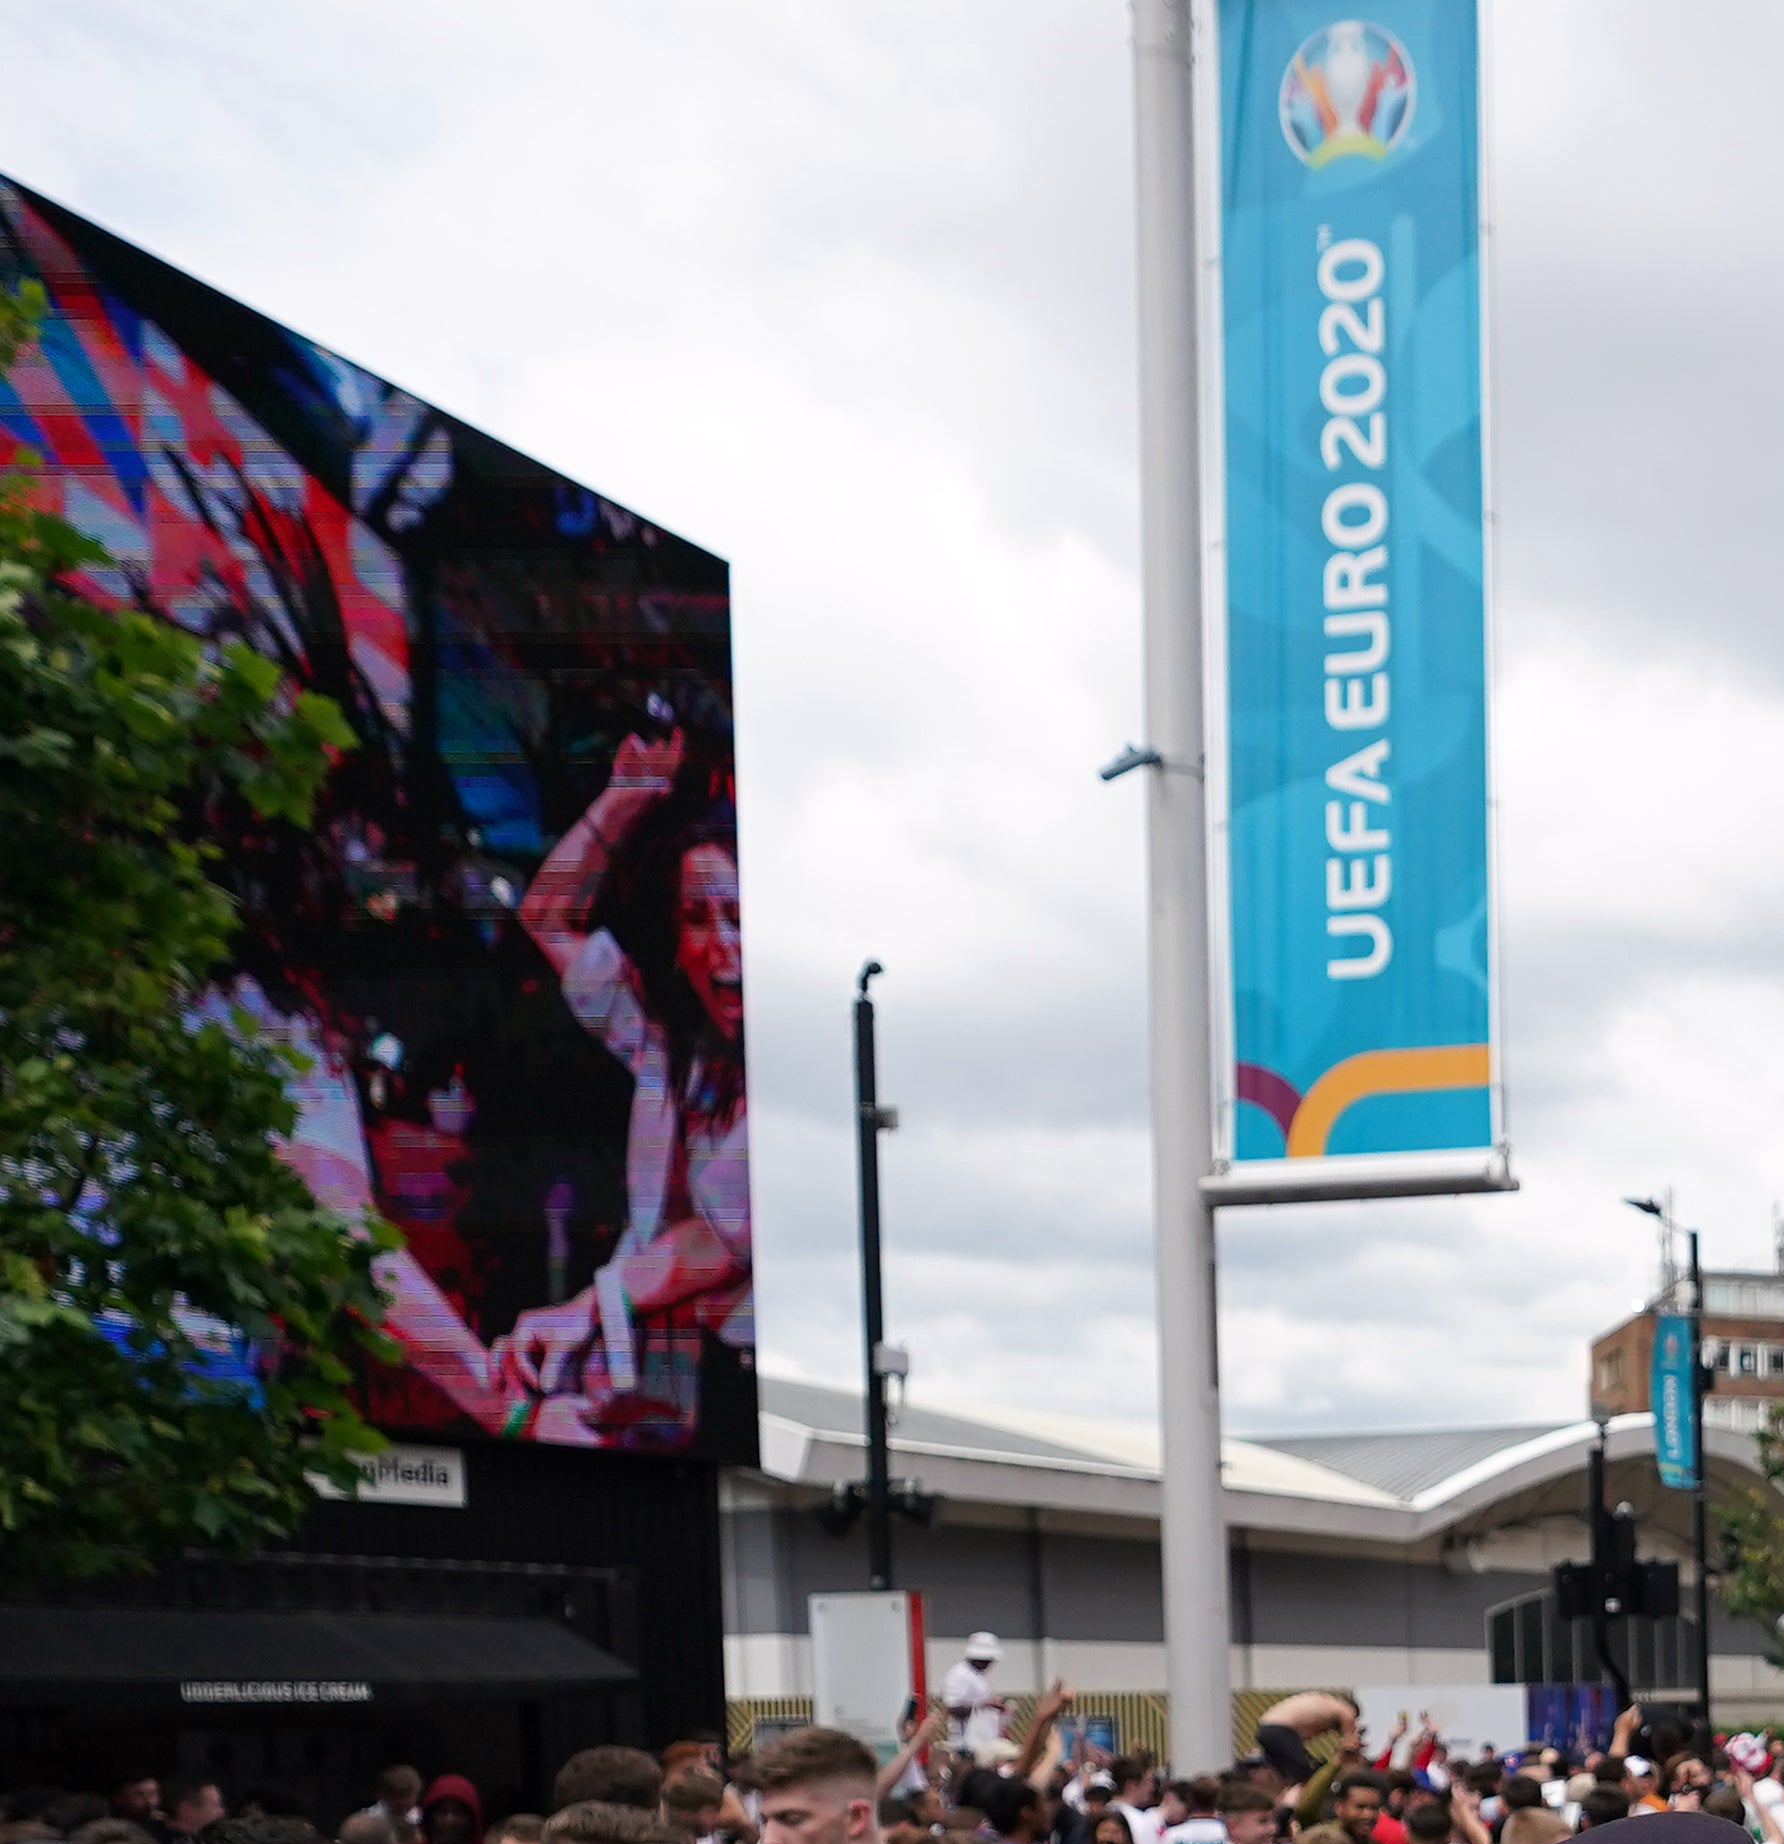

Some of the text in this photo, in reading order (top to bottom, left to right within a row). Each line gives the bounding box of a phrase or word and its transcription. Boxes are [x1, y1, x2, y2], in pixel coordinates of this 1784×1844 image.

[1320, 234, 1394, 980] UEFA EURO 2020
